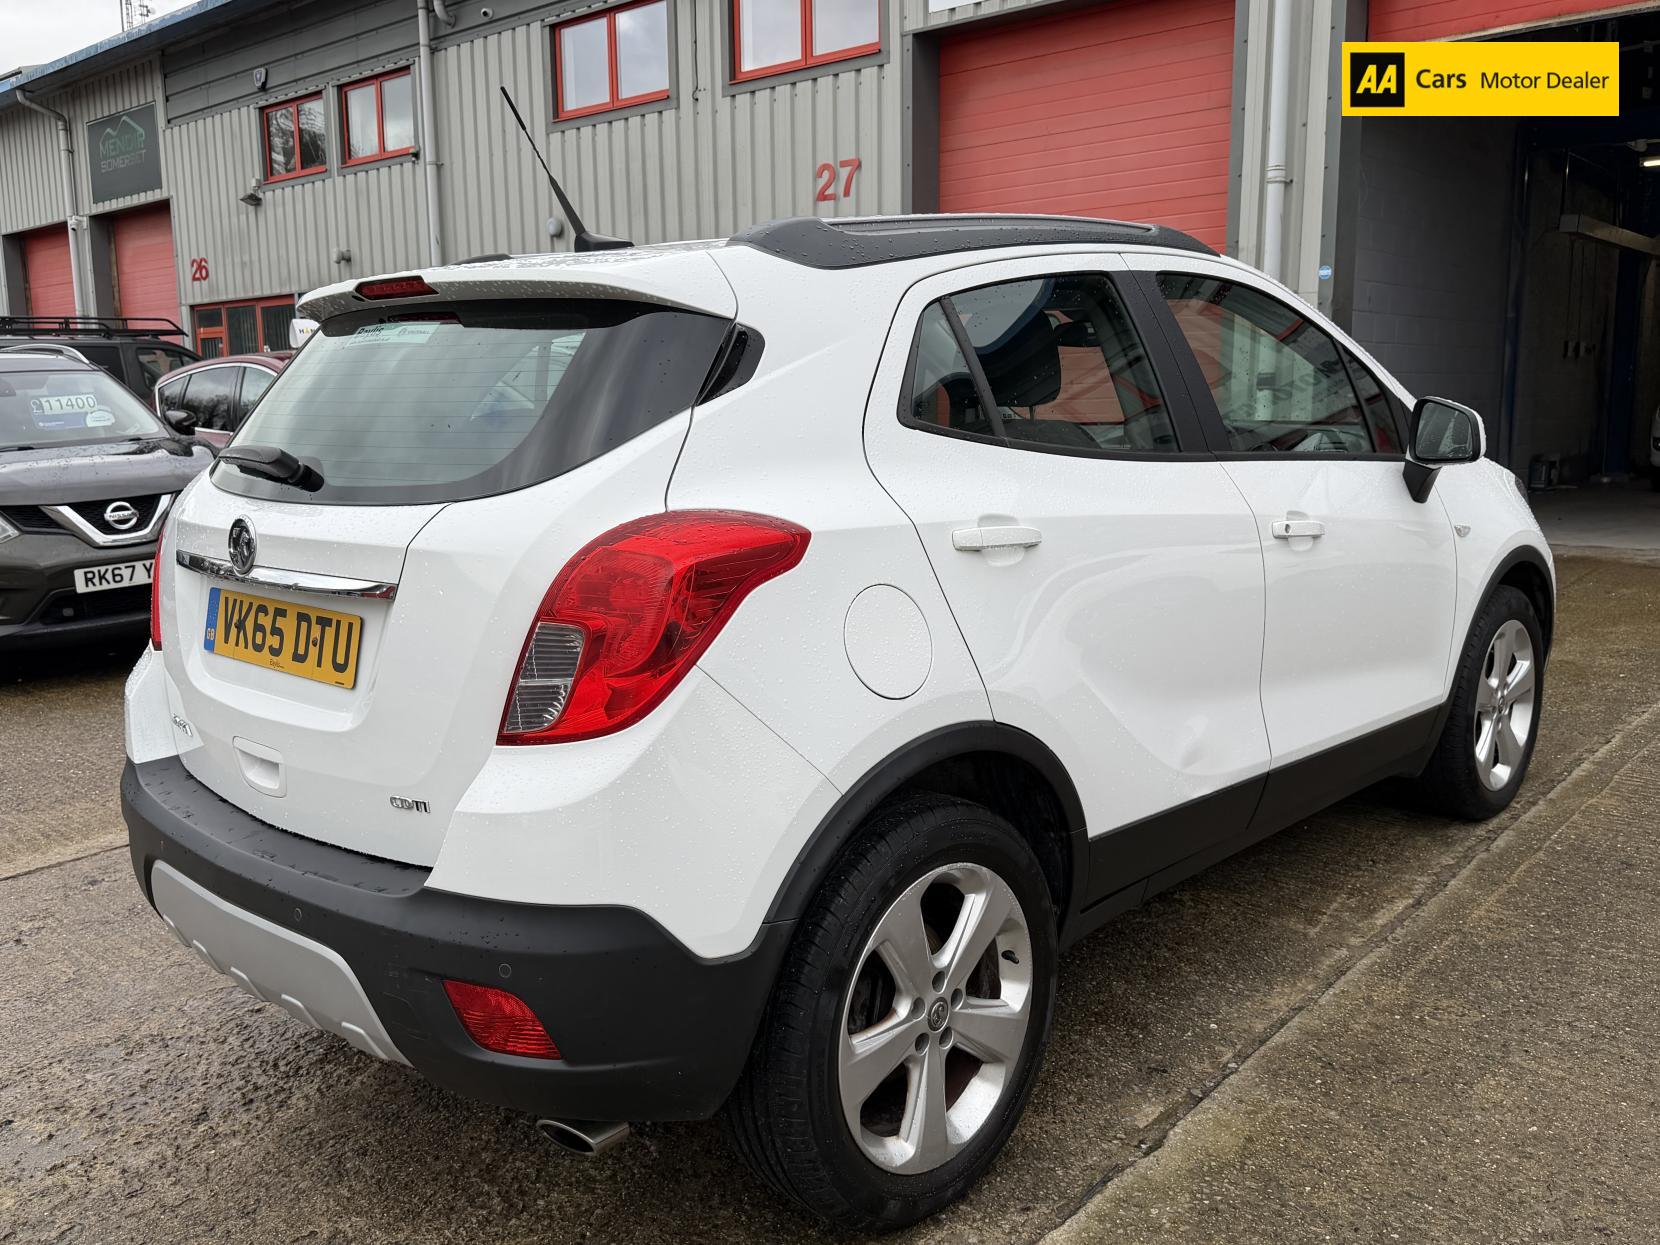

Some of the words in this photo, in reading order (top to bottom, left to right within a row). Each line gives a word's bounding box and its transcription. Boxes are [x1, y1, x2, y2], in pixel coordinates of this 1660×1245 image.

[815, 157, 862, 202] 27
[191, 256, 210, 282] 26
[83, 564, 136, 588] RK67
[206, 627, 215, 640] GB
[223, 596, 288, 658] VK65
[291, 611, 354, 674] DTU
